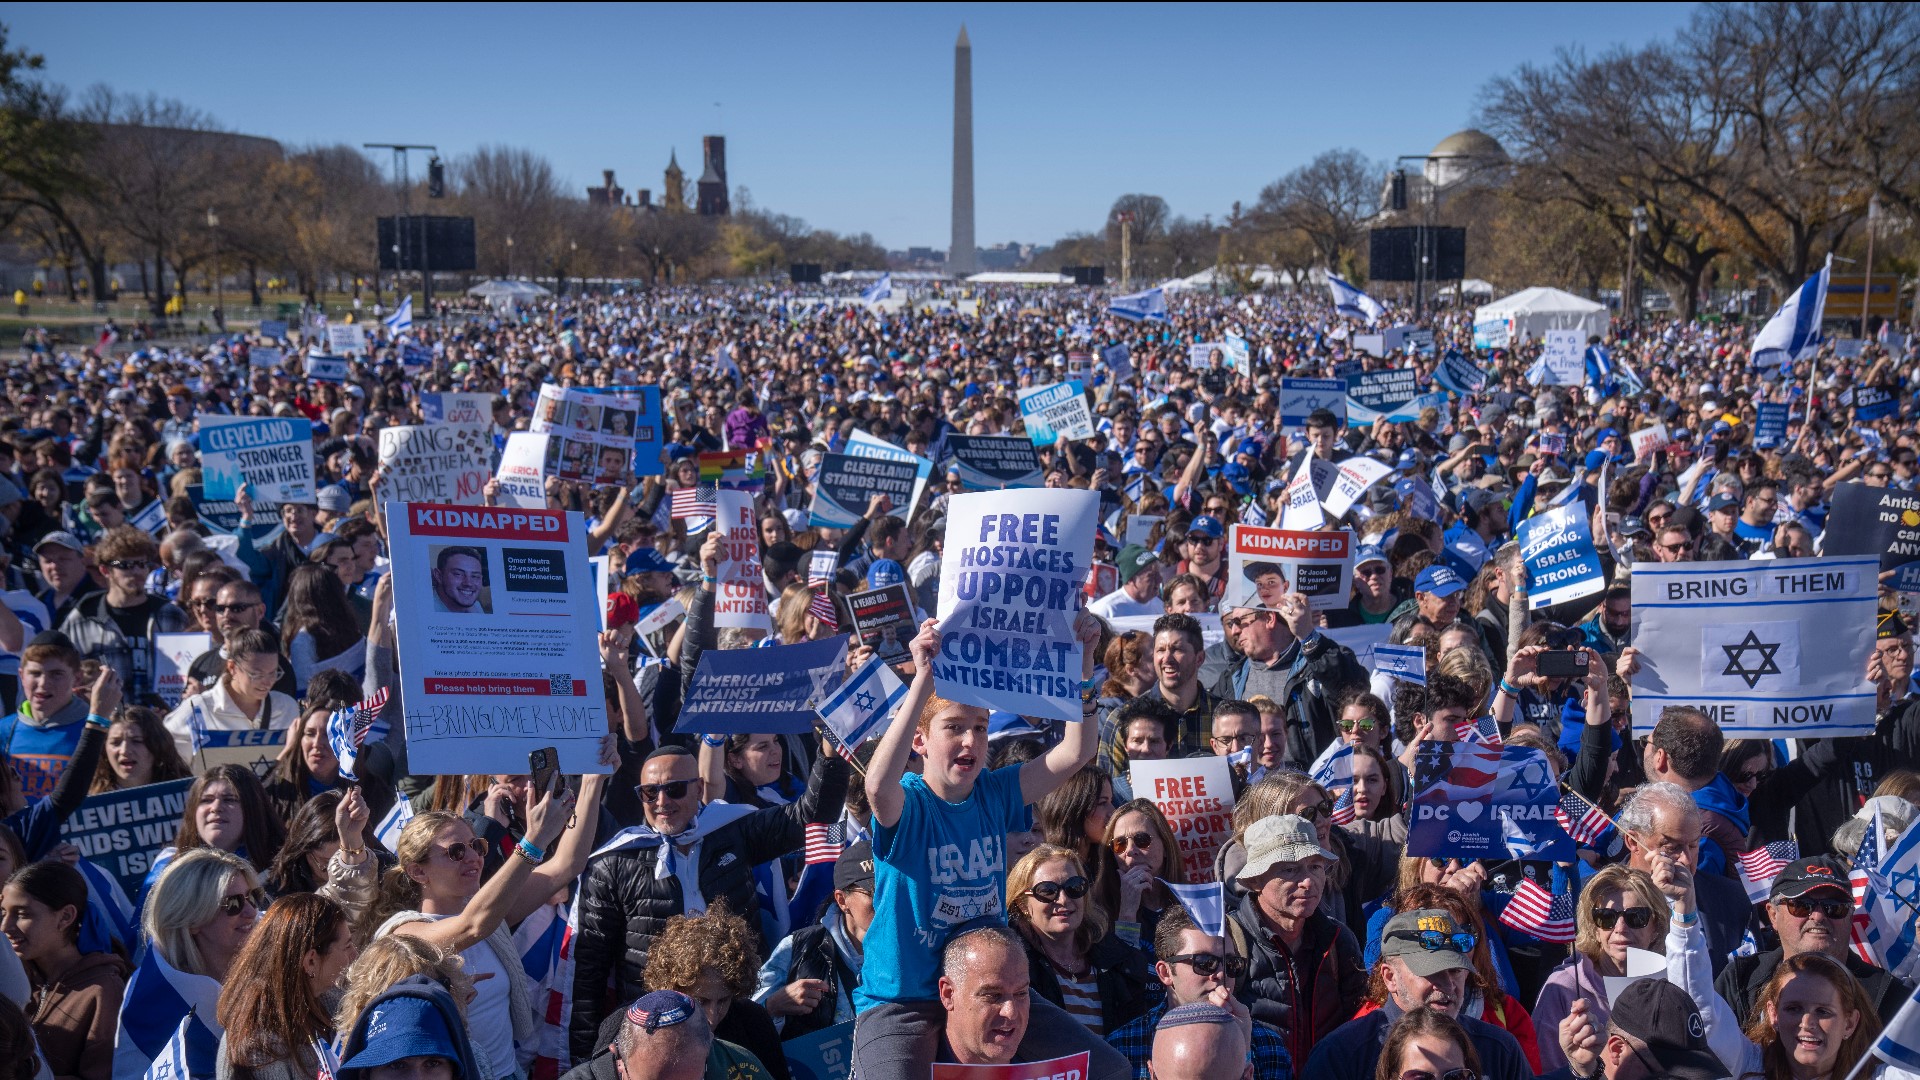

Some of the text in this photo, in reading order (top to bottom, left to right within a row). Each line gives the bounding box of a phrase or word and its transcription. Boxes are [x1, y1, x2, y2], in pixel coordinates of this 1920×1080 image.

[1546, 346, 1565, 355] Jew
[1389, 381, 1415, 392] WITH
[1857, 387, 1877, 398] FREE
[1025, 383, 1073, 412] CLEVELAND
[1383, 392, 1415, 403] ISRAEL
[448, 409, 484, 424] GAZA
[1044, 400, 1081, 421] STRONGER
[1068, 410, 1088, 426] HATE
[209, 421, 293, 450] CLEVELAND
[382, 427, 453, 458] BRING
[968, 438, 1031, 449] CLEVELAND
[238, 445, 304, 468] STRONGER
[424, 454, 473, 471] THEM
[957, 449, 1035, 461] STANDS WITH
[241, 463, 310, 487] THAN HATE
[843, 460, 914, 479] CLEVELAND
[998, 460, 1039, 471] ISRAEL
[394, 475, 447, 501] HOME
[522, 476, 540, 485] WITH
[824, 472, 912, 493] STANDS WITH
[198, 502, 238, 515] STAND
[1879, 511, 1898, 522] no
[416, 509, 560, 532] KIDNAPPED
[979, 513, 1060, 545] FREE
[1528, 514, 1576, 540] BOSTON
[1241, 533, 1343, 552] KIDNAPPED
[1528, 531, 1582, 555] STRONG.
[960, 546, 1074, 574] HOSTAGES
[1535, 548, 1581, 568] ISRAEL
[508, 565, 550, 573] 22-years-old
[509, 573, 564, 581] Israeli-American
[1535, 563, 1592, 587] STRONG.
[1667, 572, 1845, 600] BRING THEM
[853, 600, 859, 609] 4
[859, 595, 876, 607] YEARS
[876, 593, 888, 604] OLD
[971, 605, 1047, 635] ISRAEL
[941, 631, 1071, 673] COMBAT
[454, 670, 470, 678] photo
[696, 671, 784, 687] AMERICANS
[933, 661, 1082, 700] ANTISEMITISM
[434, 684, 535, 694] Please help bring them
[691, 687, 760, 700] AGAINST
[686, 700, 798, 713] ANTISEMITISM
[1773, 703, 1834, 724] NOW
[1154, 776, 1207, 799] FREE
[1418, 805, 1450, 820] DC
[928, 835, 1004, 884] ISRAEL
